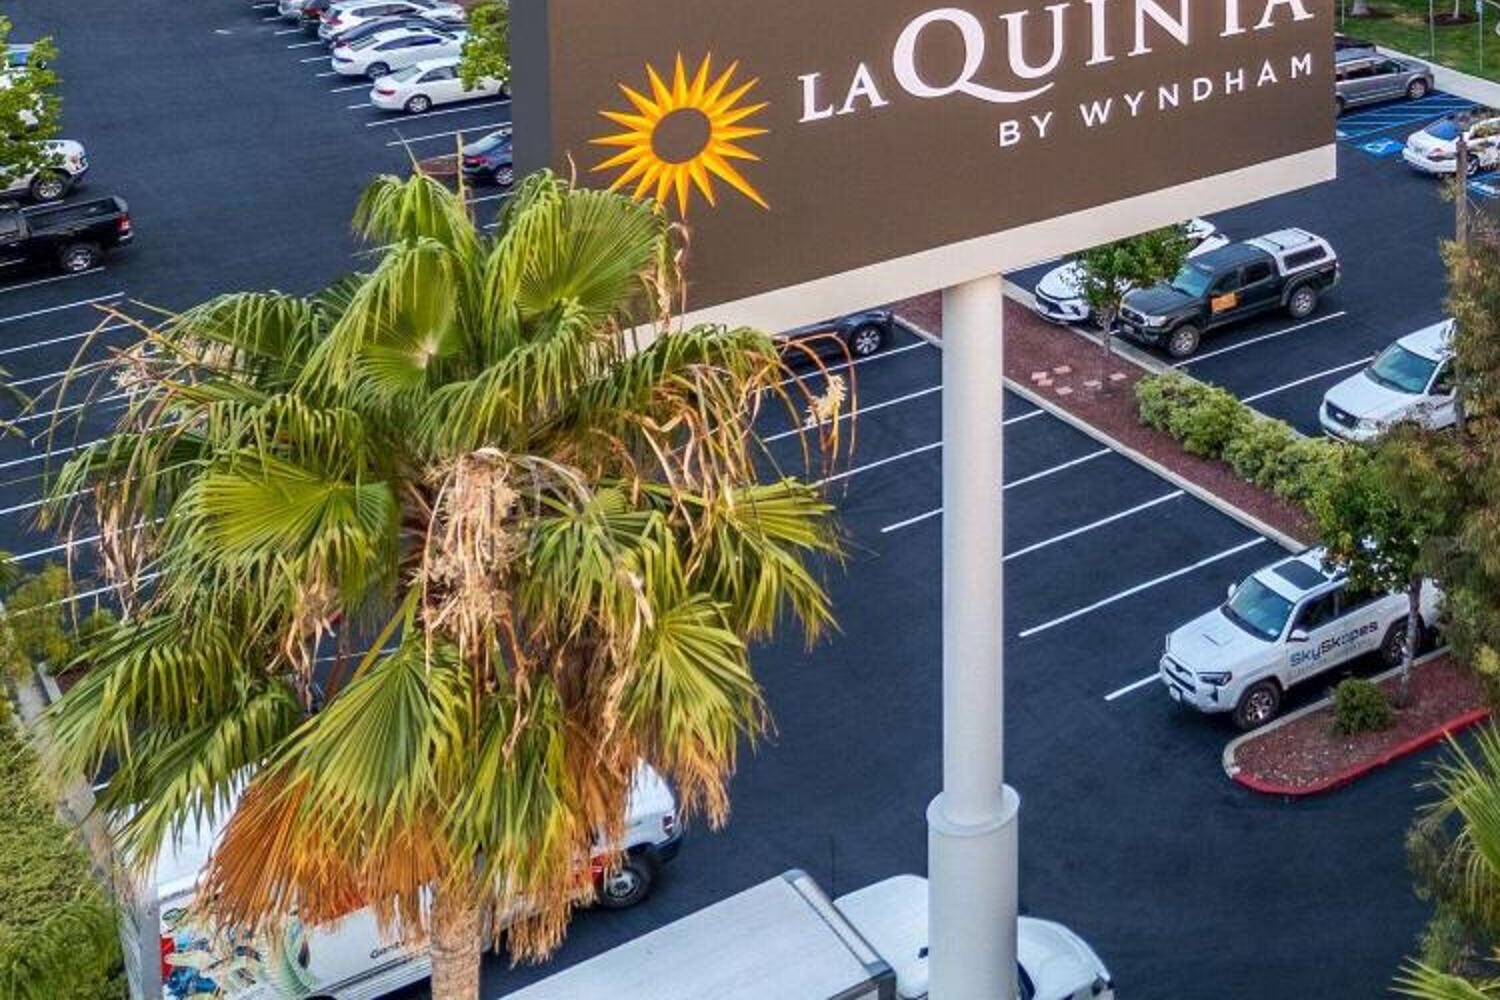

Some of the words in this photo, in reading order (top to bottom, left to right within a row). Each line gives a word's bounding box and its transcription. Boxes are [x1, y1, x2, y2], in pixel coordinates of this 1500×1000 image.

[797, 62, 889, 123] LA
[999, 111, 1053, 147] BY
[1079, 52, 1312, 127] WYNDHAM
